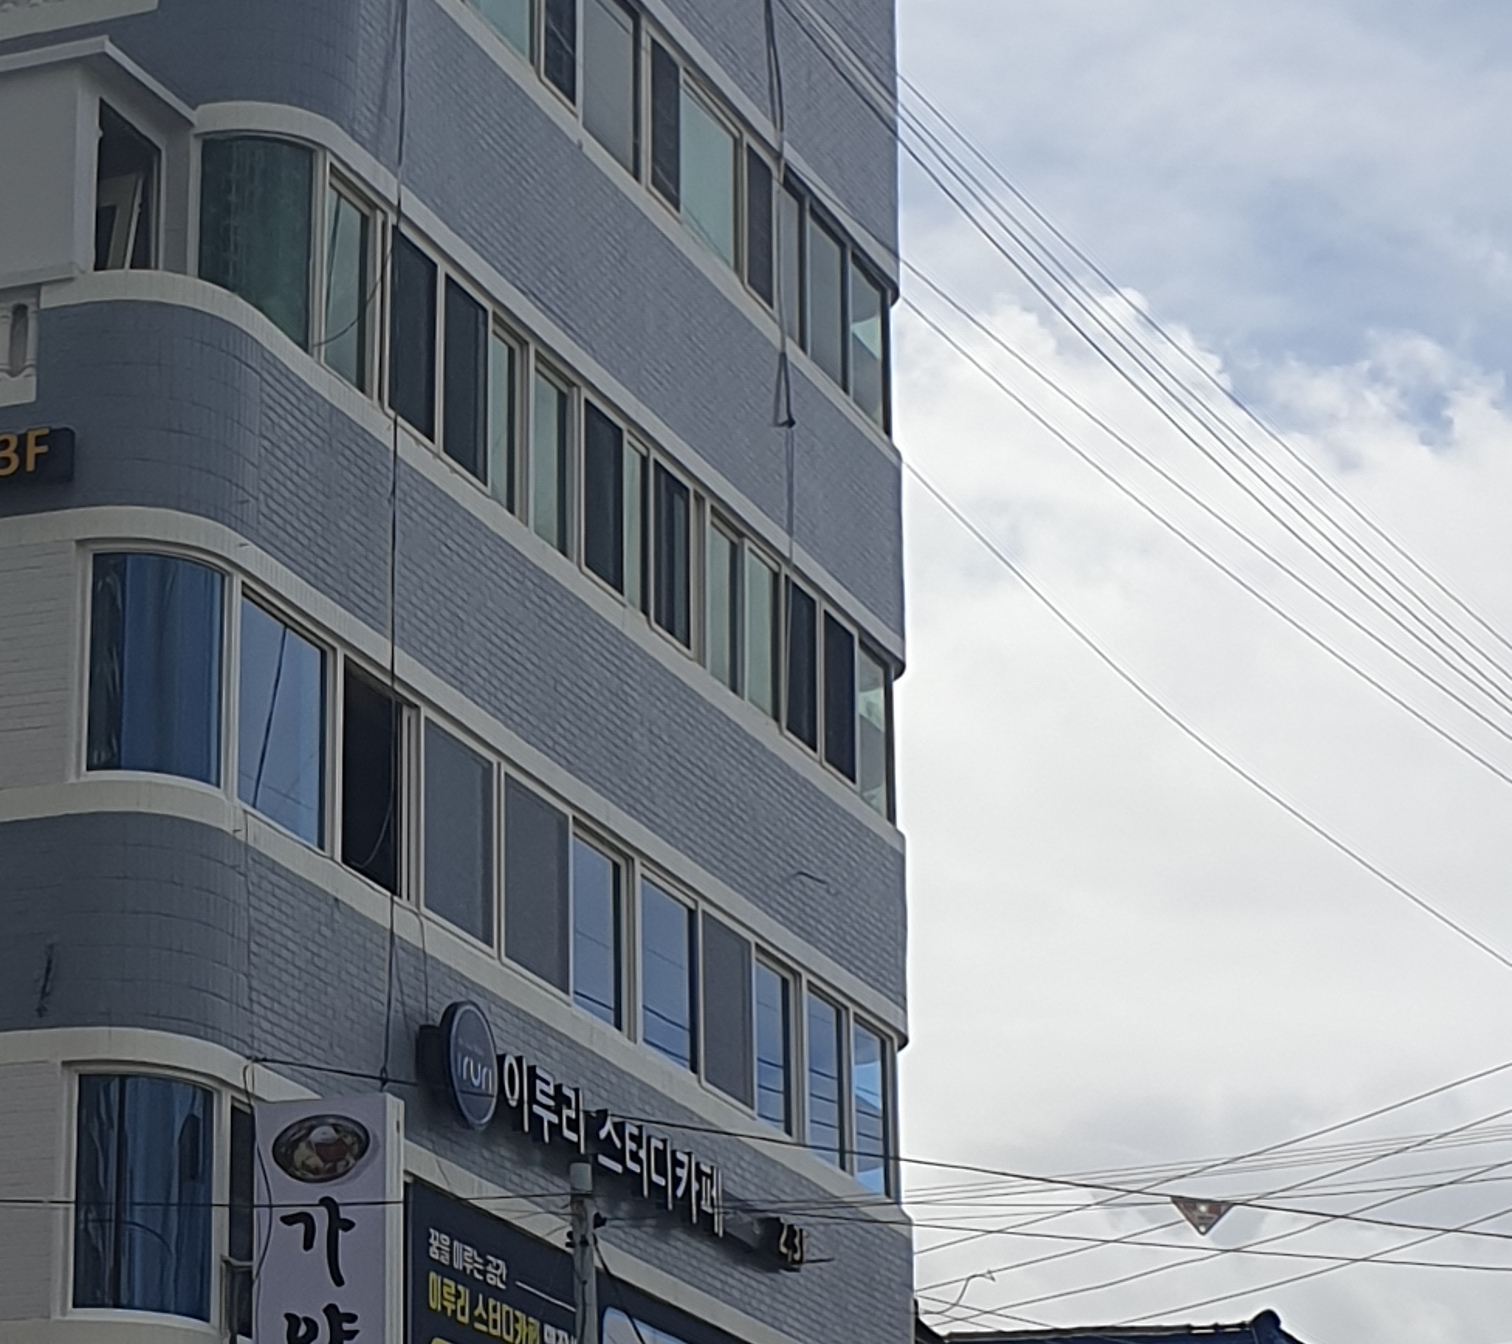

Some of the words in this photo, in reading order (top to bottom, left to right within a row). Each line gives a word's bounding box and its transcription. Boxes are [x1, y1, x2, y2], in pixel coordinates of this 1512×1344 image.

[504, 1054, 586, 1154] 이루리
[597, 1118, 723, 1238] 스터디카페
[453, 1239, 484, 1280] 이루는
[428, 1271, 469, 1325] 이루리
